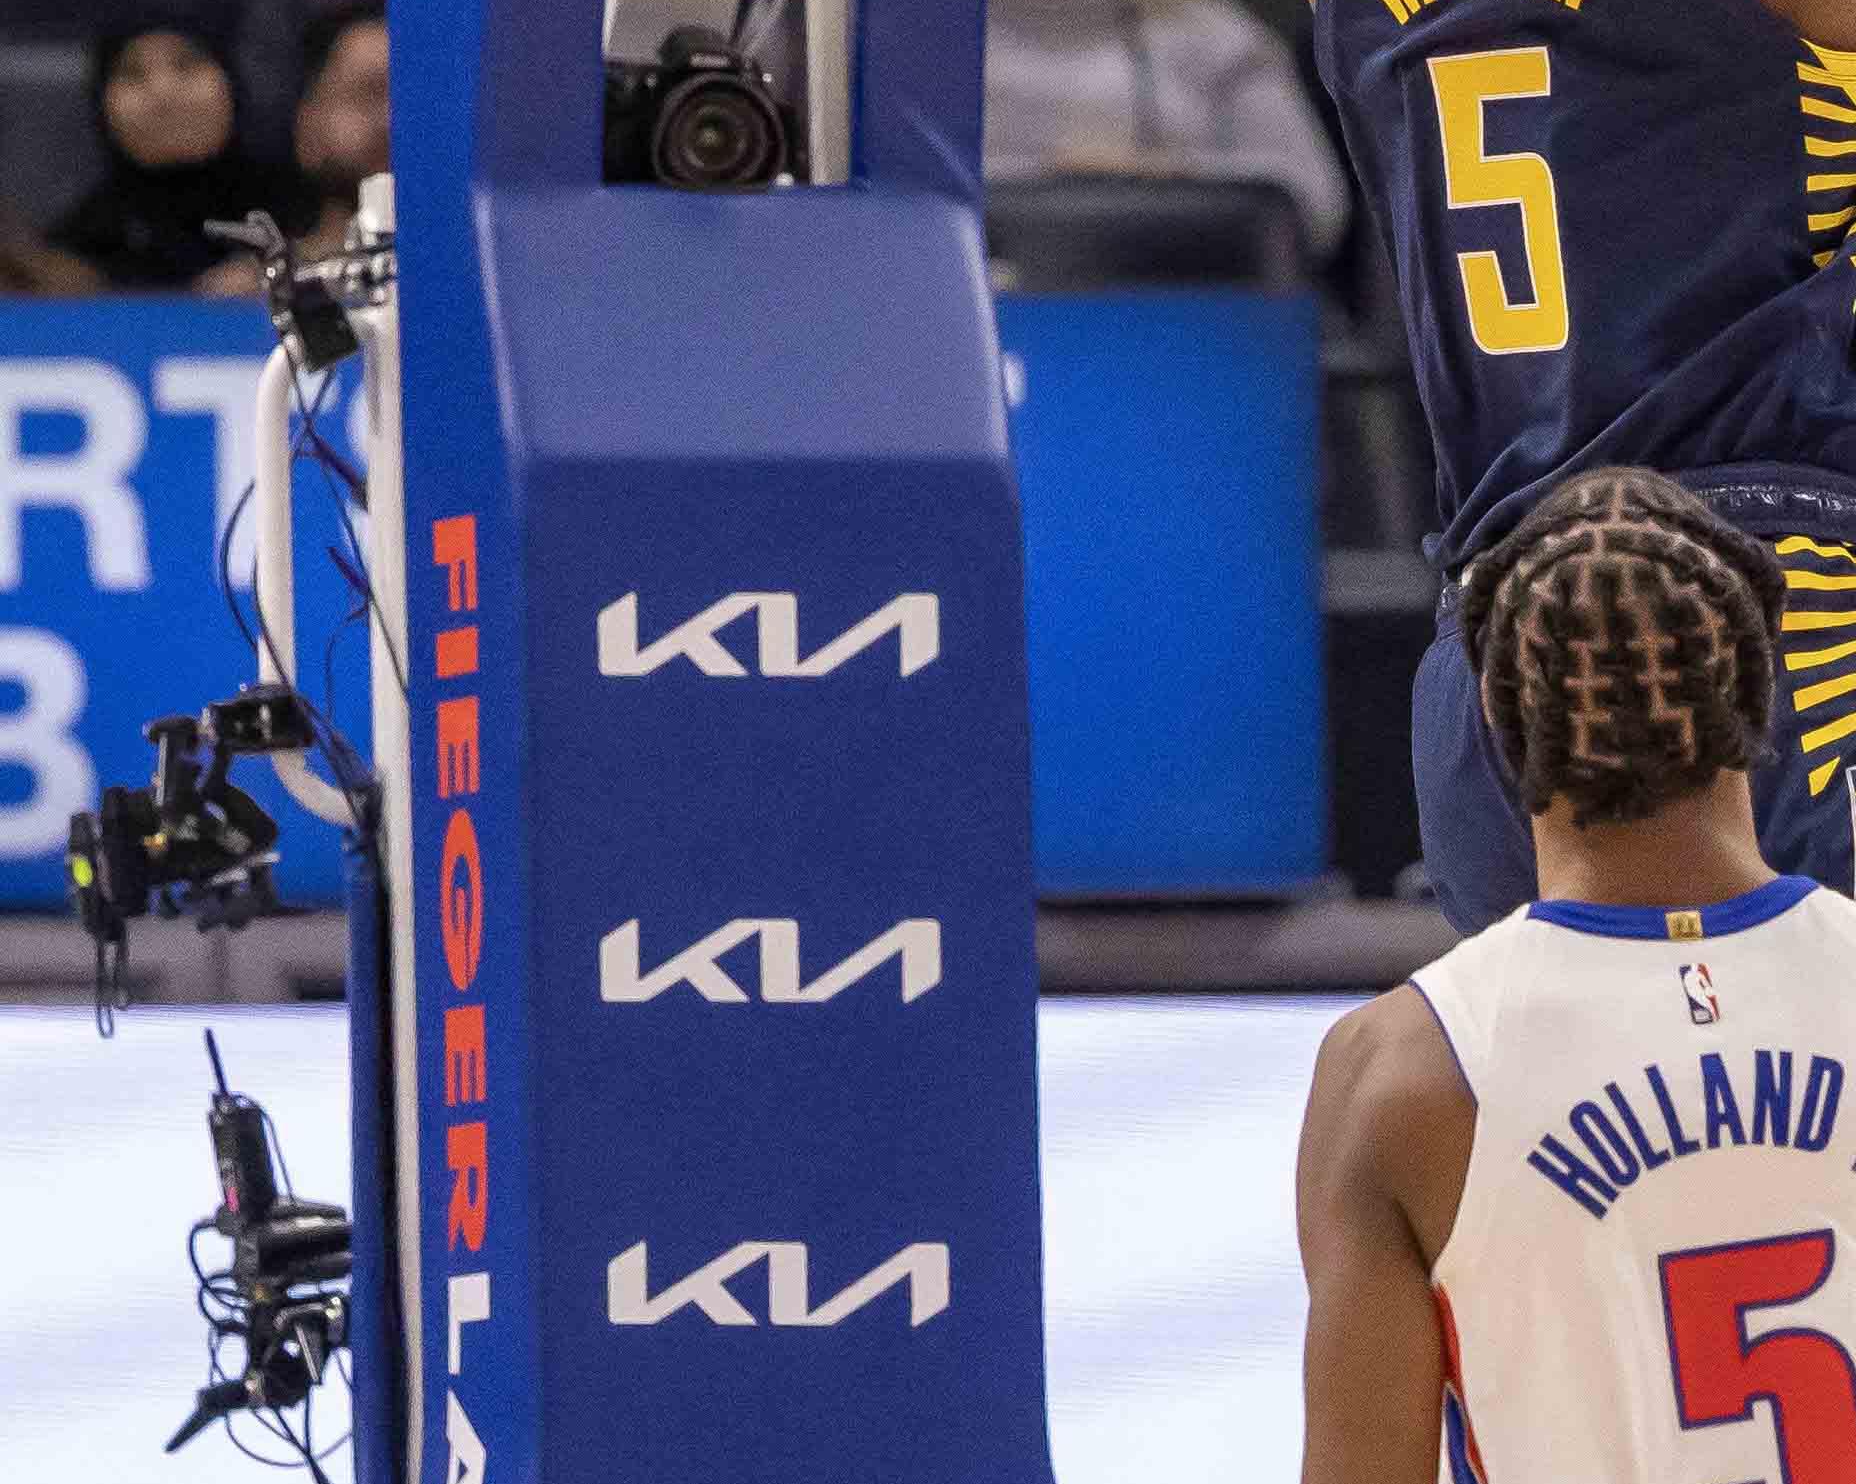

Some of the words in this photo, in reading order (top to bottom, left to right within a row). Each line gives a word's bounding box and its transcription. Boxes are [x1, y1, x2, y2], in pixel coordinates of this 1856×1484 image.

[1425, 44, 1569, 355] 5
[599, 591, 940, 678] KIA
[431, 515, 489, 1253] FIEGER
[600, 917, 942, 1004] KIA
[1525, 1048, 1846, 1221] HOLLAND
[607, 1241, 951, 1328] KIA
